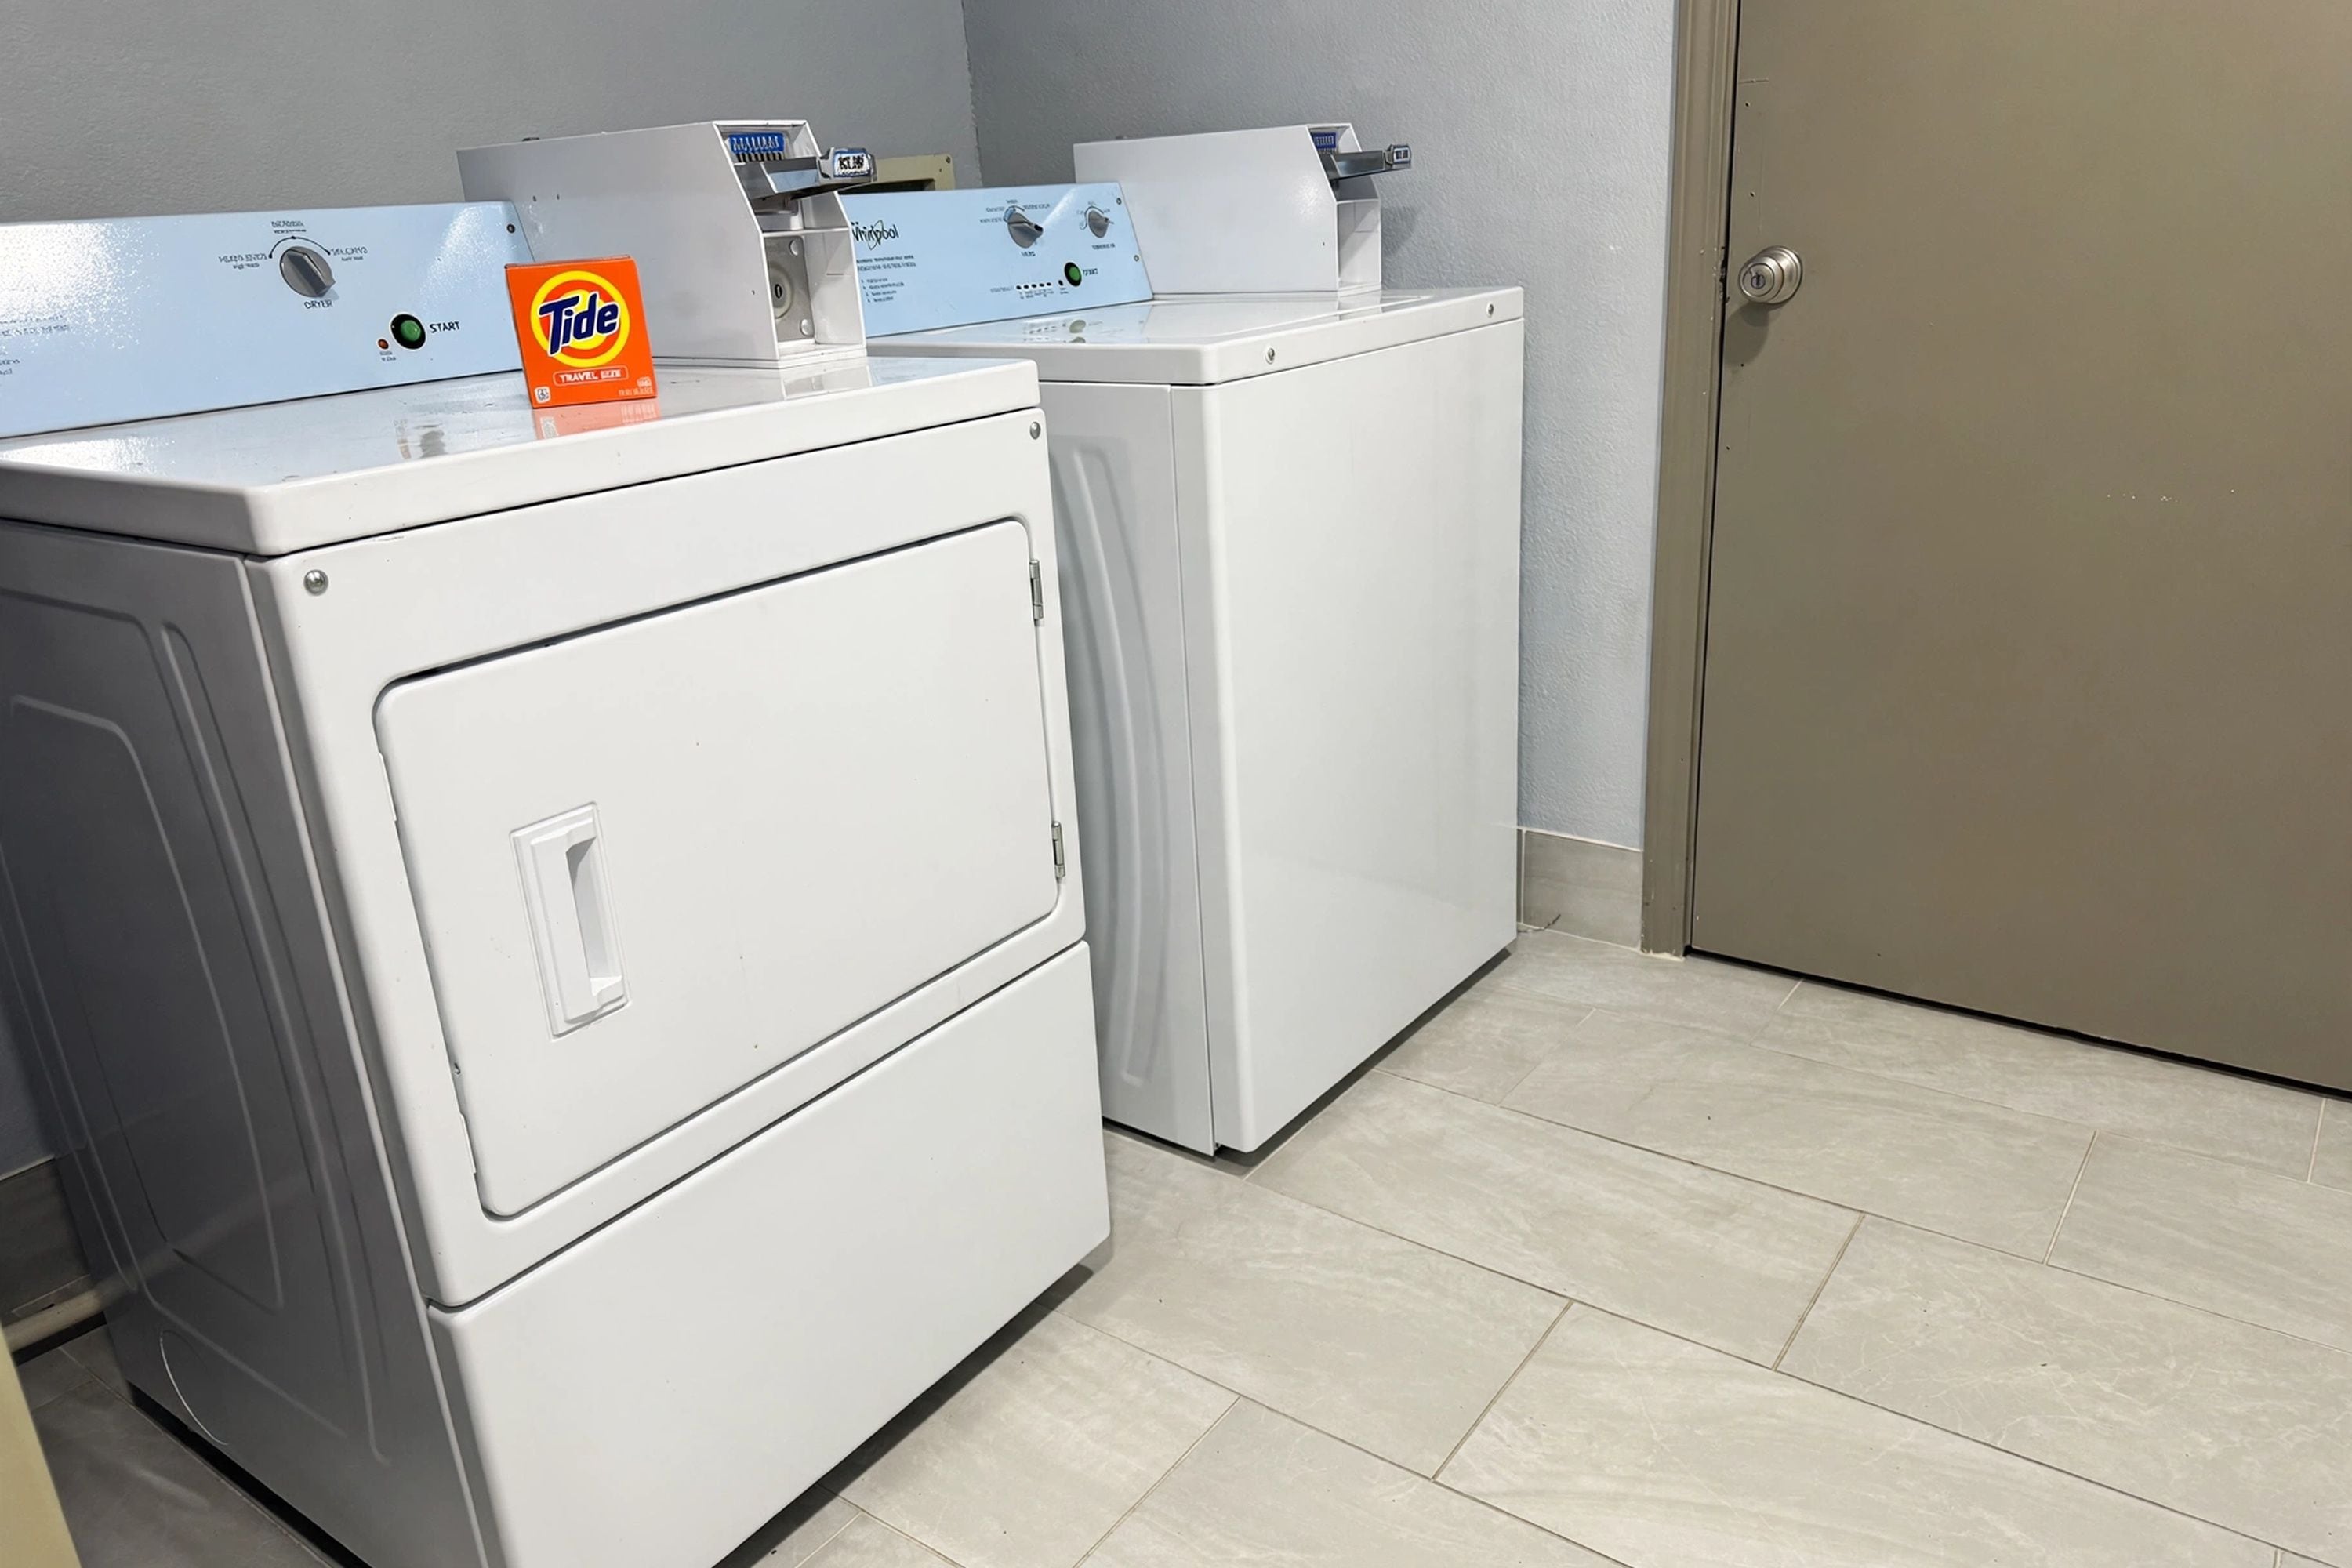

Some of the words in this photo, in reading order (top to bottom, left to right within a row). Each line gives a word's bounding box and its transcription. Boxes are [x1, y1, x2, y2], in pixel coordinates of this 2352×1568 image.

[303, 299, 334, 310] DRYER
[429, 321, 460, 333] START
[538, 292, 620, 356] Tide
[558, 370, 599, 383] TRAVEL
